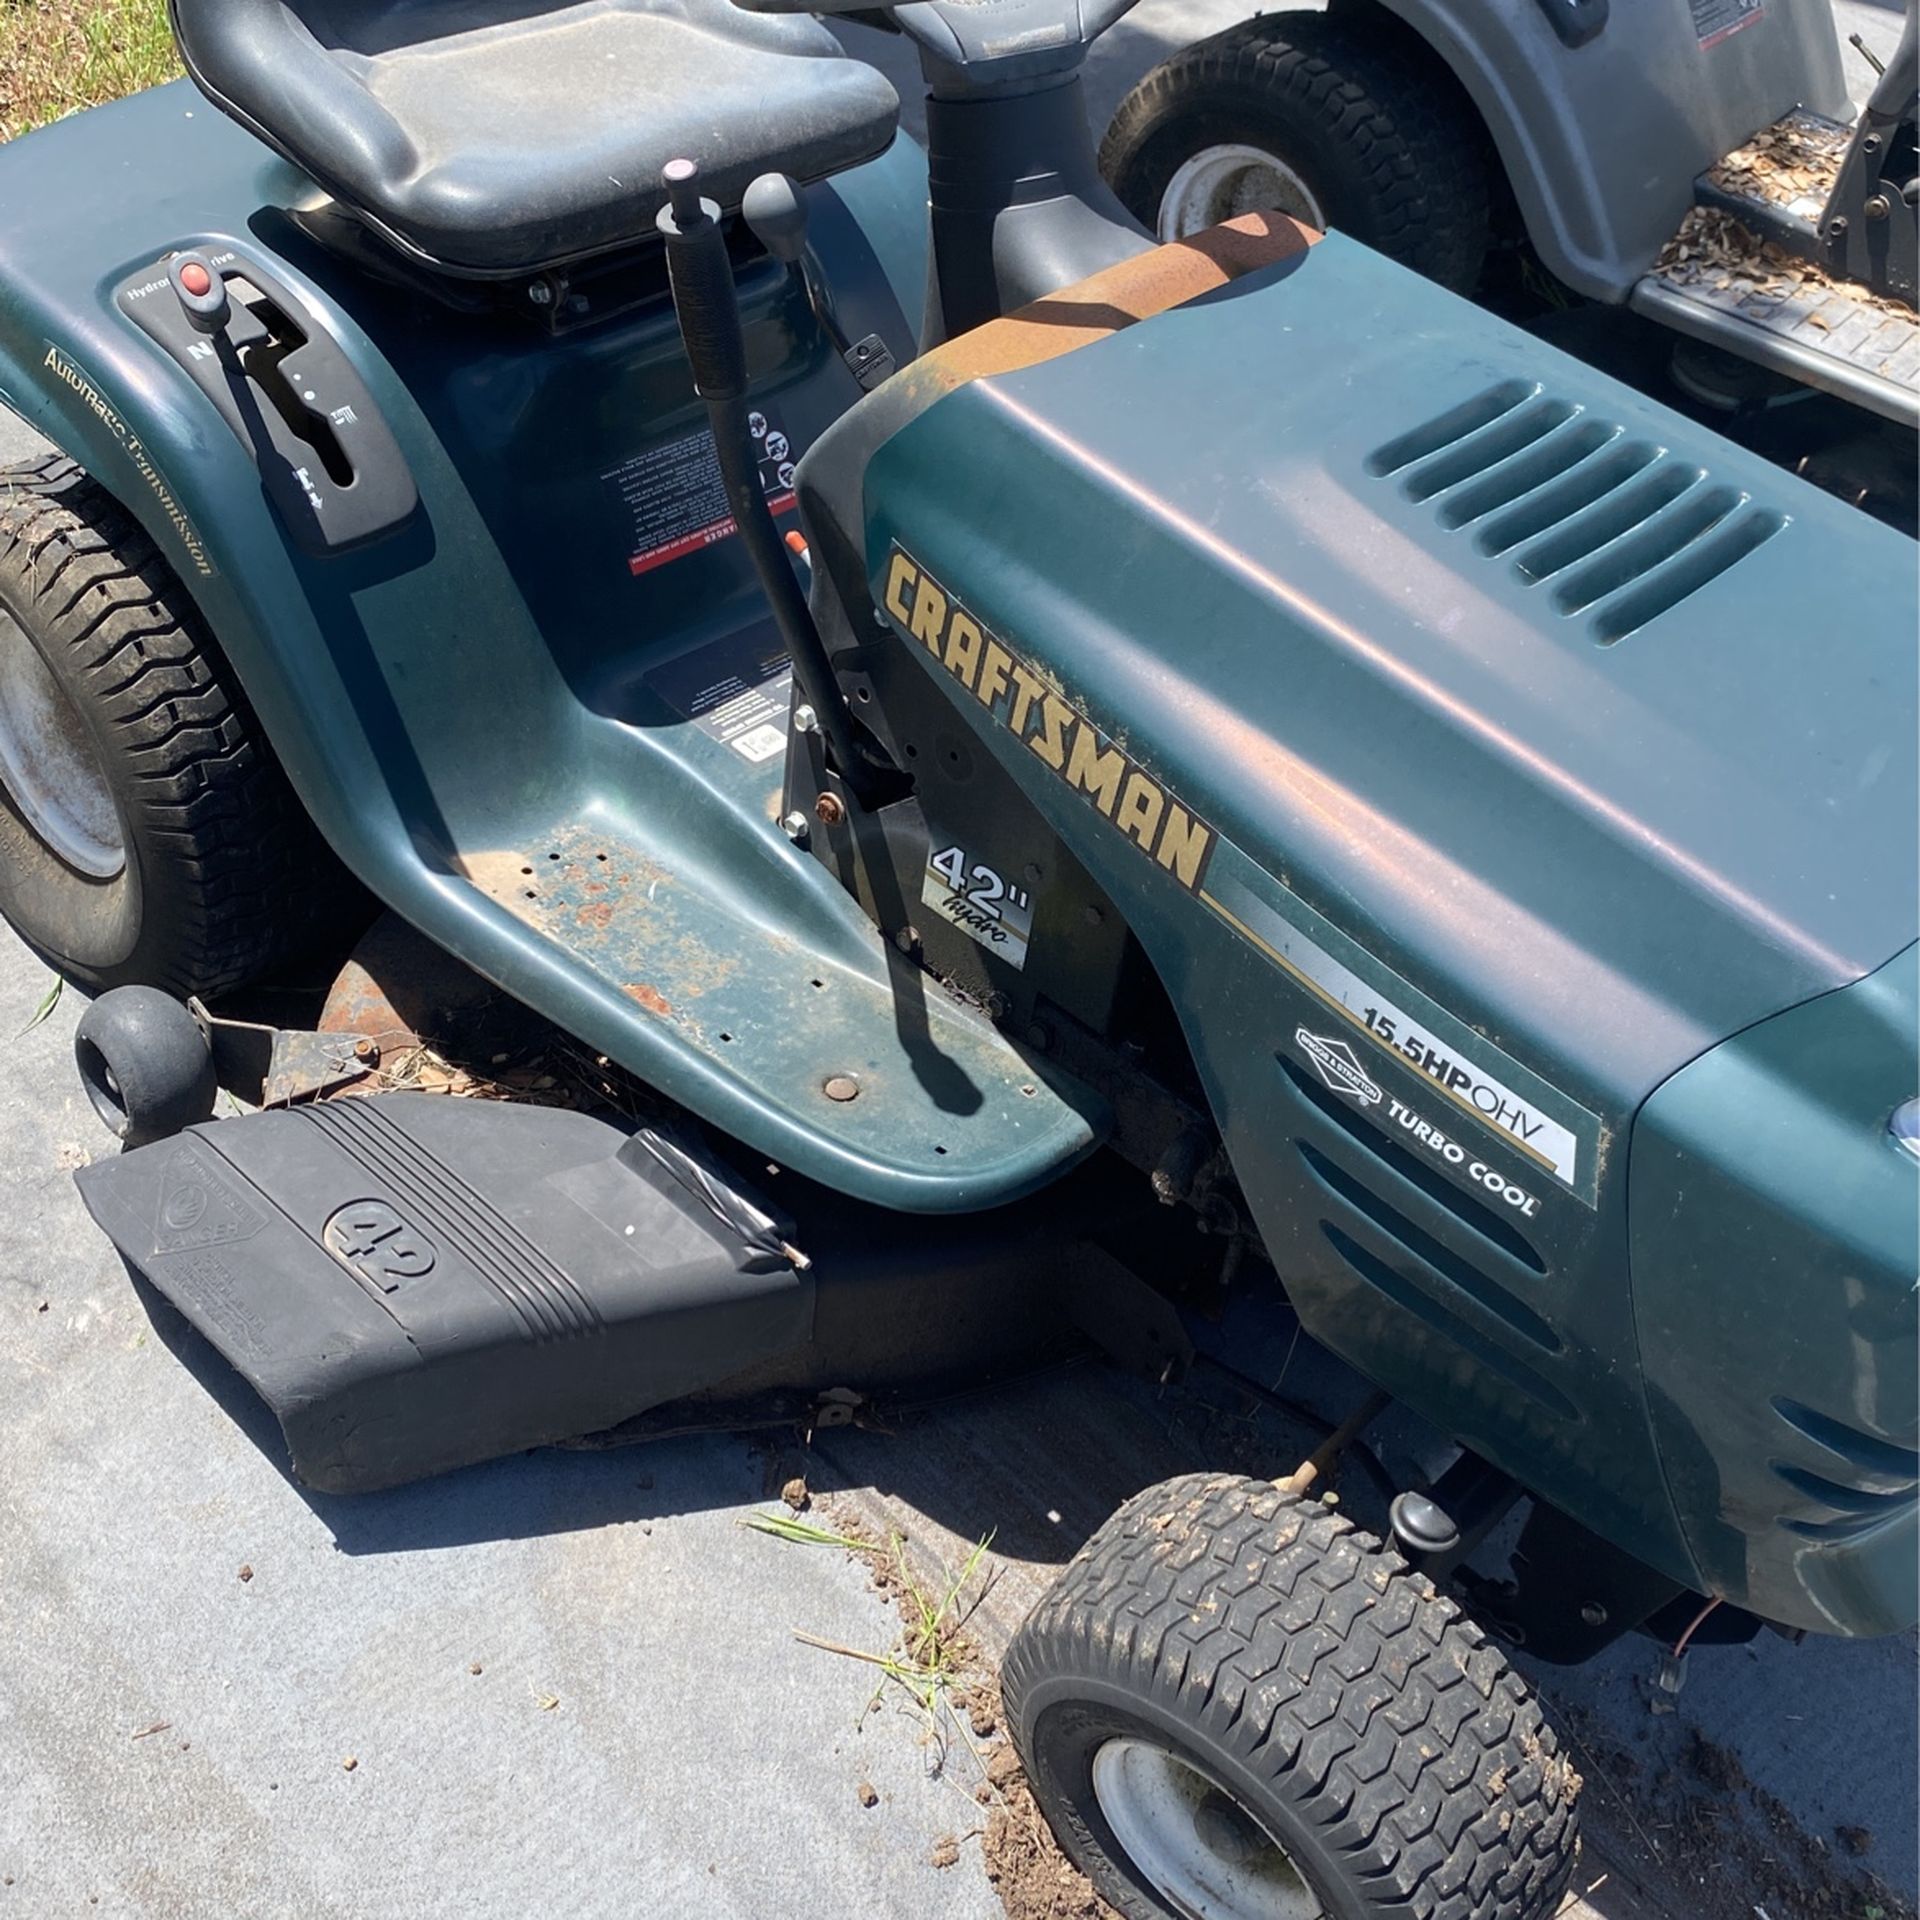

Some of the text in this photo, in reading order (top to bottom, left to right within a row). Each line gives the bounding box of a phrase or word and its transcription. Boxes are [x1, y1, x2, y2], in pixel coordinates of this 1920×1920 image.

[187, 341, 213, 360] N
[44, 348, 213, 576] Automatic Transmission
[884, 551, 1210, 890] CRAFTSMAN
[931, 846, 1028, 919] 42"
[942, 895, 1008, 944] hydro
[1389, 1100, 1536, 1217] TURBO COOL
[333, 1222, 436, 1295] 42
